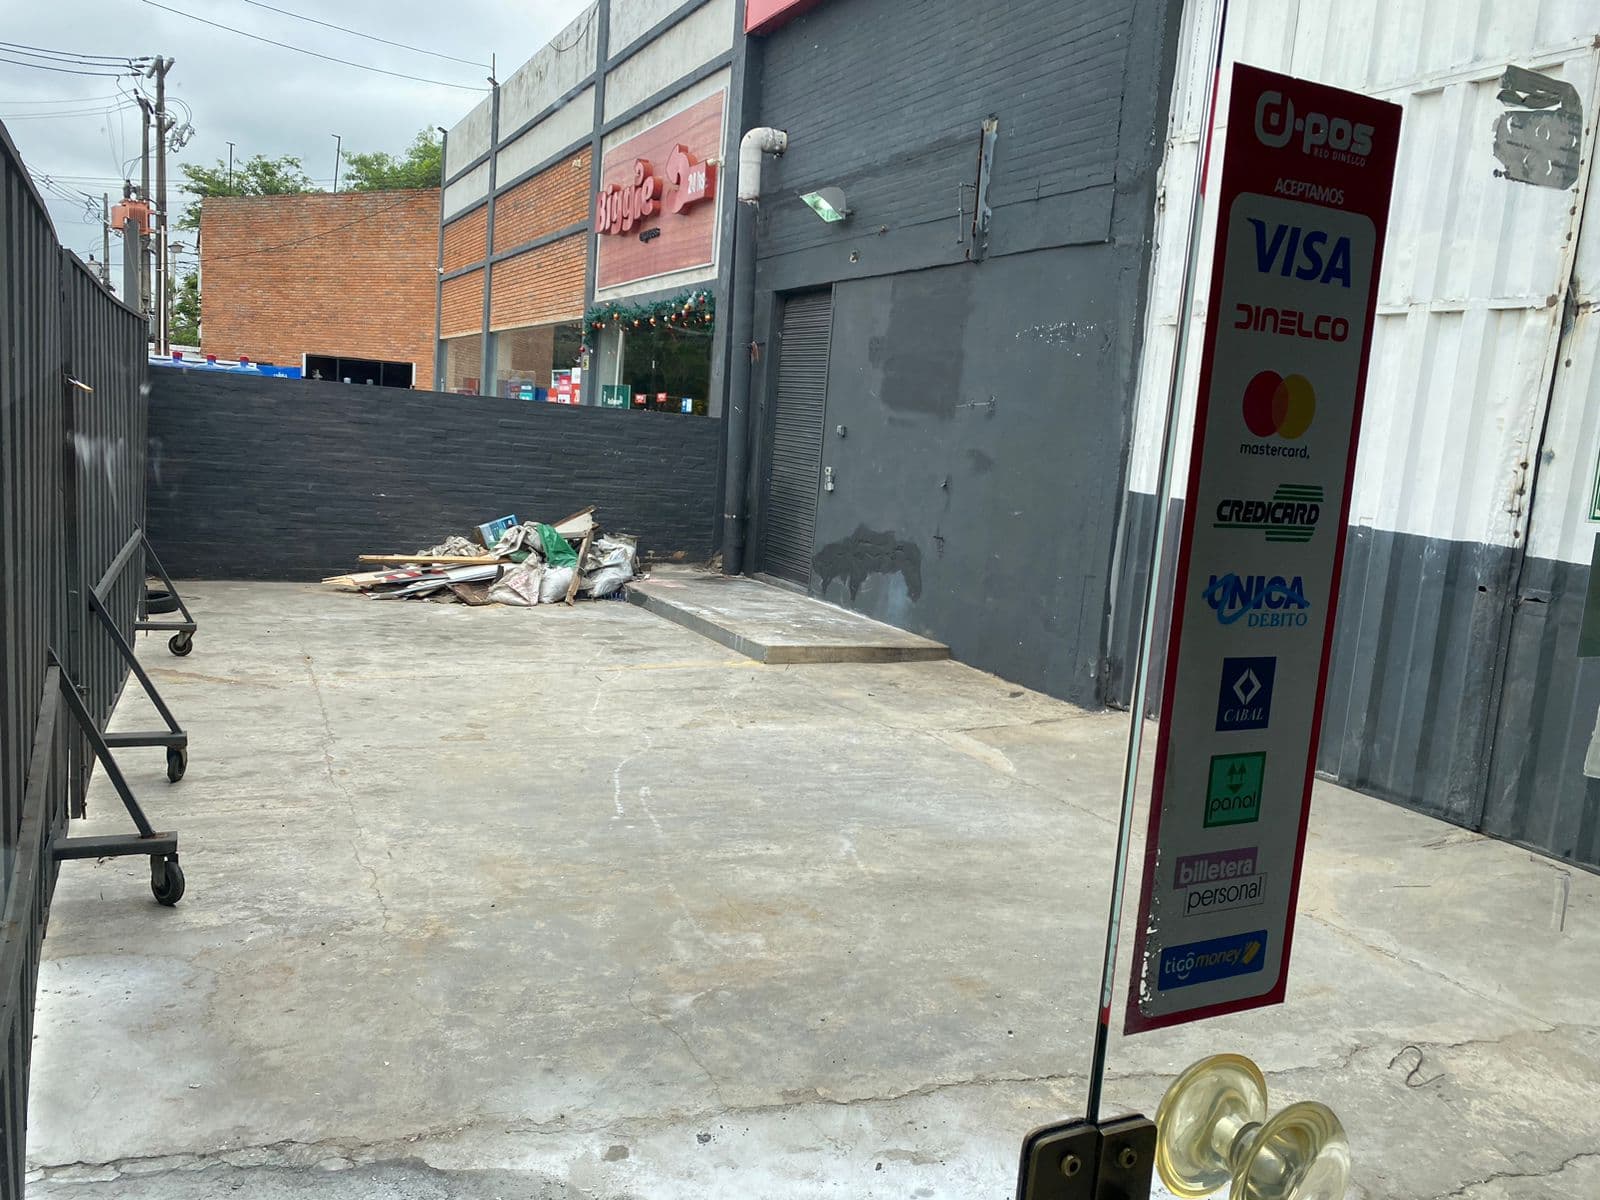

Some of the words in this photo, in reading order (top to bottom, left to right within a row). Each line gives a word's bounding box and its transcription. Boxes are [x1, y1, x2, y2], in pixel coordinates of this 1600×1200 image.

[595, 158, 663, 234] Biggie
[1274, 177, 1344, 205] ACEPTAMOS
[1246, 217, 1351, 288] VISA
[1234, 303, 1349, 342] DINELCO
[1216, 499, 1320, 526] CREDICARD
[1223, 707, 1264, 722] CABAL
[1209, 792, 1256, 820] panal
[1180, 858, 1253, 884] billetera
[1187, 876, 1262, 914] personal
